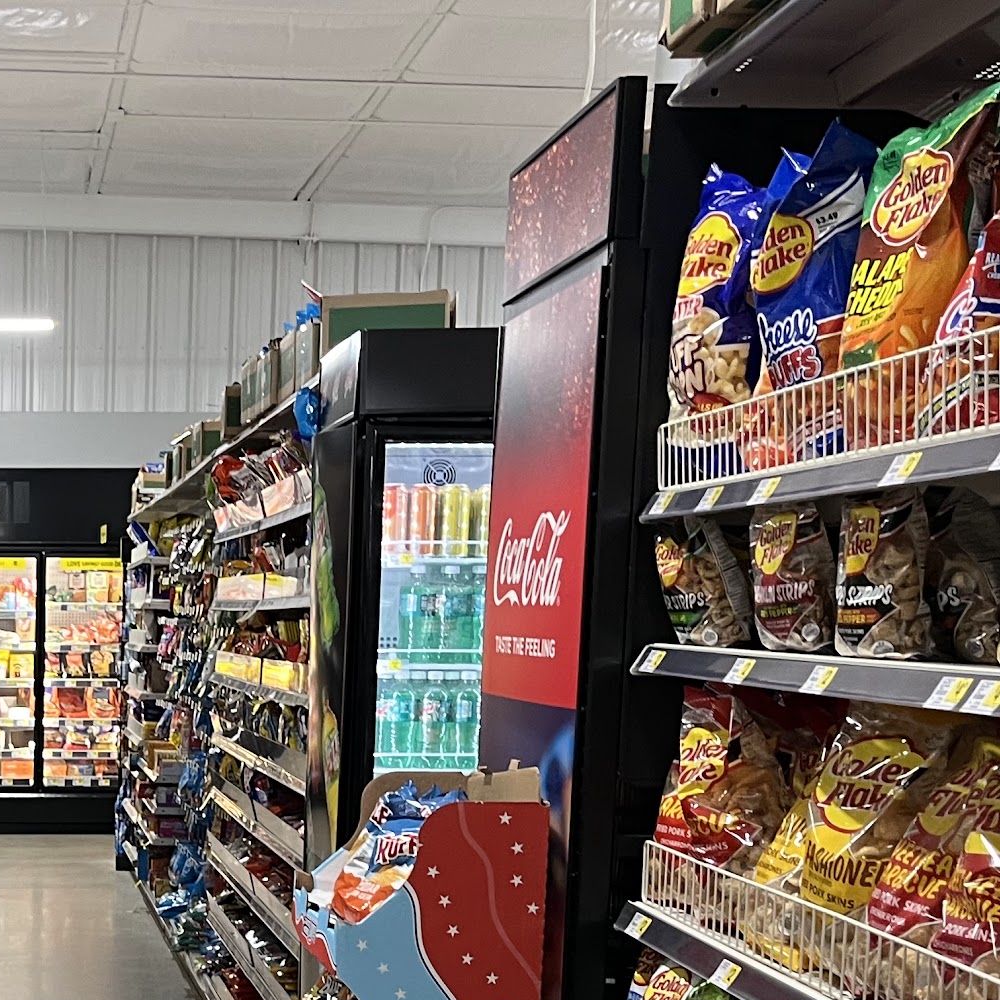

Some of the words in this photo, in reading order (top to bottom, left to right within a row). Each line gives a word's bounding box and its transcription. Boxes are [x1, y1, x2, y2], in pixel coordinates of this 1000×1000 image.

[883, 162, 948, 209] Golden
[493, 509, 571, 608] Coca-Cola
[776, 580, 816, 602] STRIPS
[495, 635, 512, 654] TASTE
[513, 638, 524, 655] THE
[525, 639, 556, 659] FEELING
[827, 892, 855, 910] SKINS
